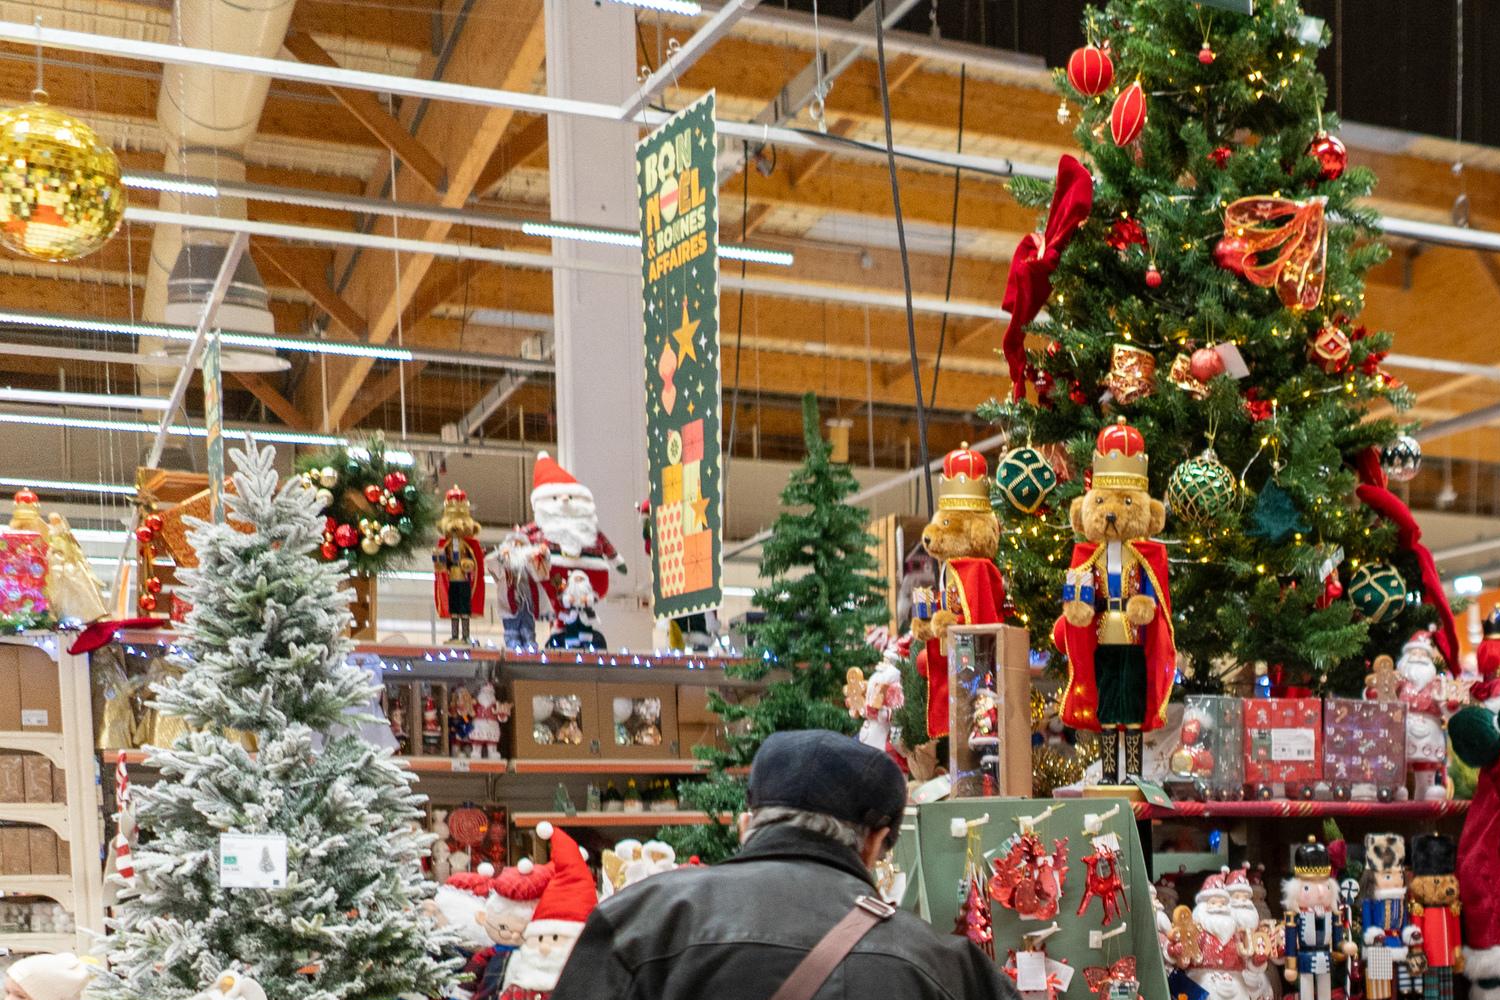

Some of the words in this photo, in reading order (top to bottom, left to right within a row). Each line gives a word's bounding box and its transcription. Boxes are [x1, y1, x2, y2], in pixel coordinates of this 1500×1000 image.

[644, 128, 692, 195] BON
[648, 234, 656, 260] &
[656, 205, 706, 254] BONNES
[648, 231, 708, 284] AFFAIRES
